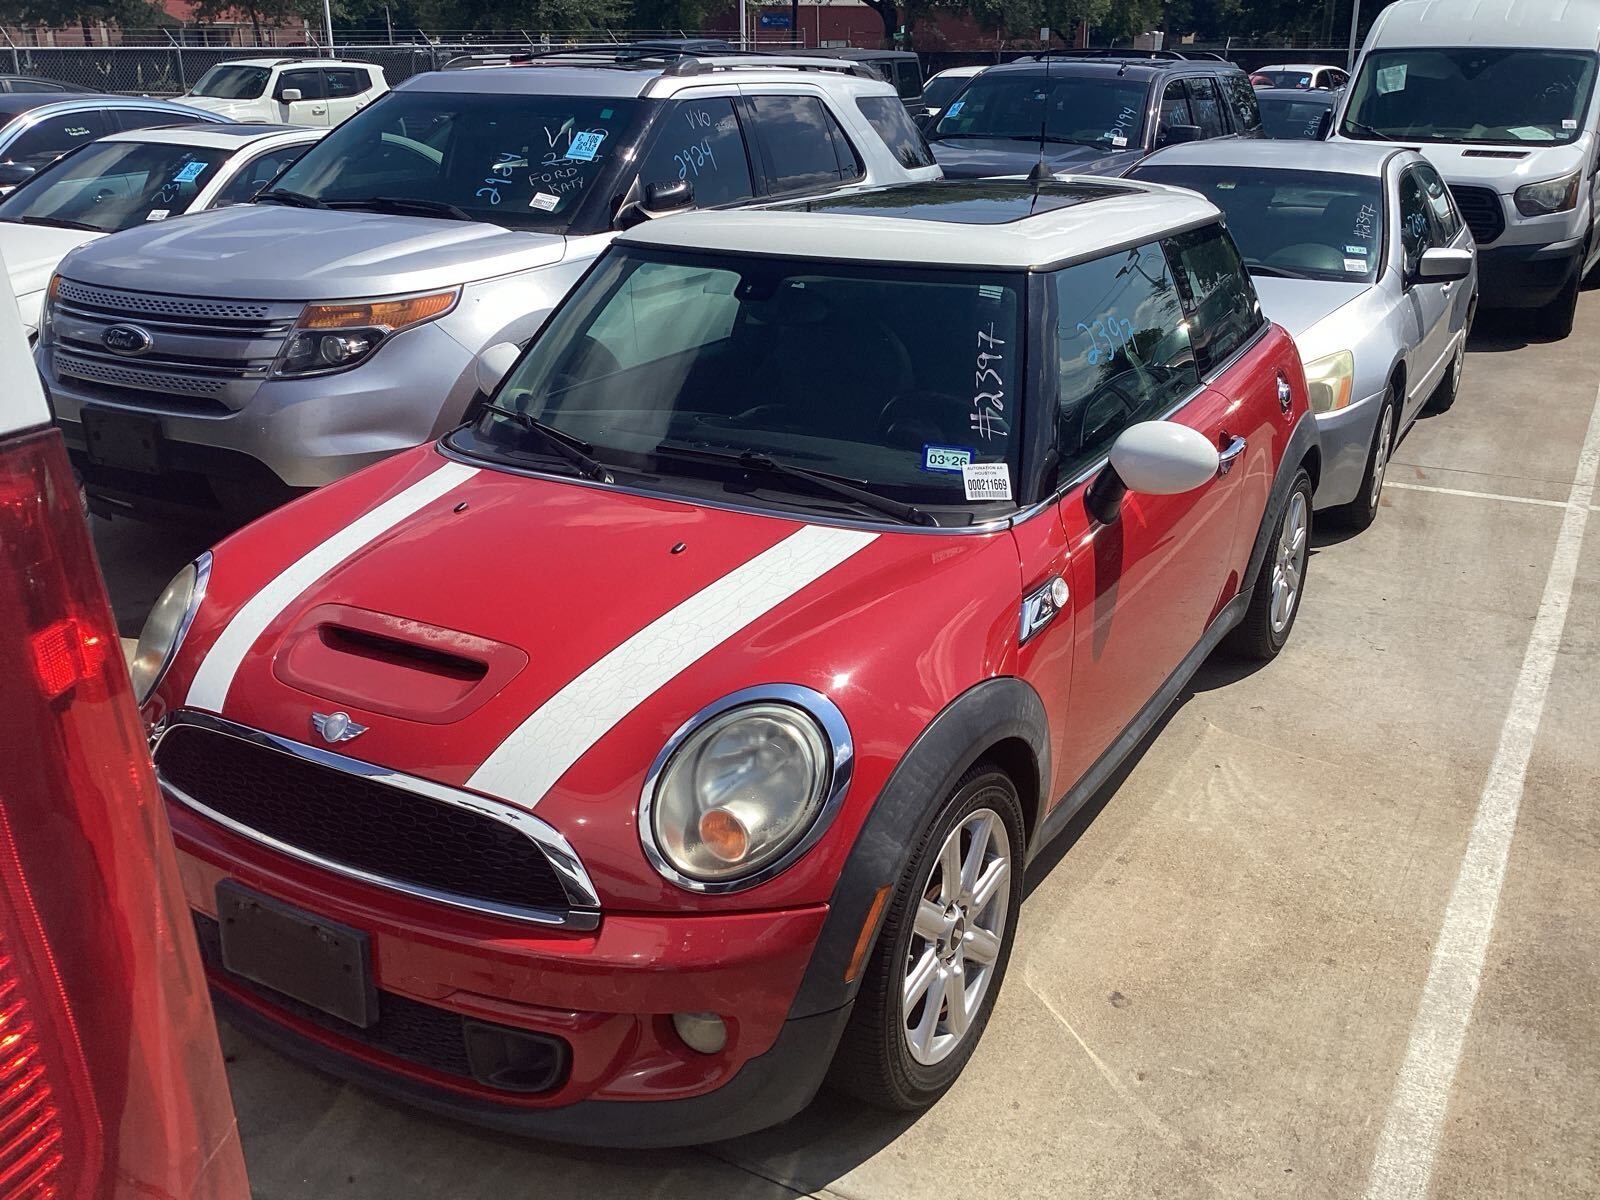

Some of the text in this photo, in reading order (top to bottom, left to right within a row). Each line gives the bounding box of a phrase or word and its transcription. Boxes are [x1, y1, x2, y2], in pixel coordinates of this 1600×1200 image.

[1304, 115, 1321, 136] 2494
[669, 139, 718, 180] 2924
[528, 167, 578, 187] FORD
[548, 176, 584, 194] KATY
[1353, 203, 1377, 239] #2397
[107, 328, 135, 347] Ford
[1076, 317, 1139, 365] 2397
[970, 322, 1008, 441] #2397
[929, 454, 968, 466] 03 26
[967, 479, 1008, 491] 000211669
